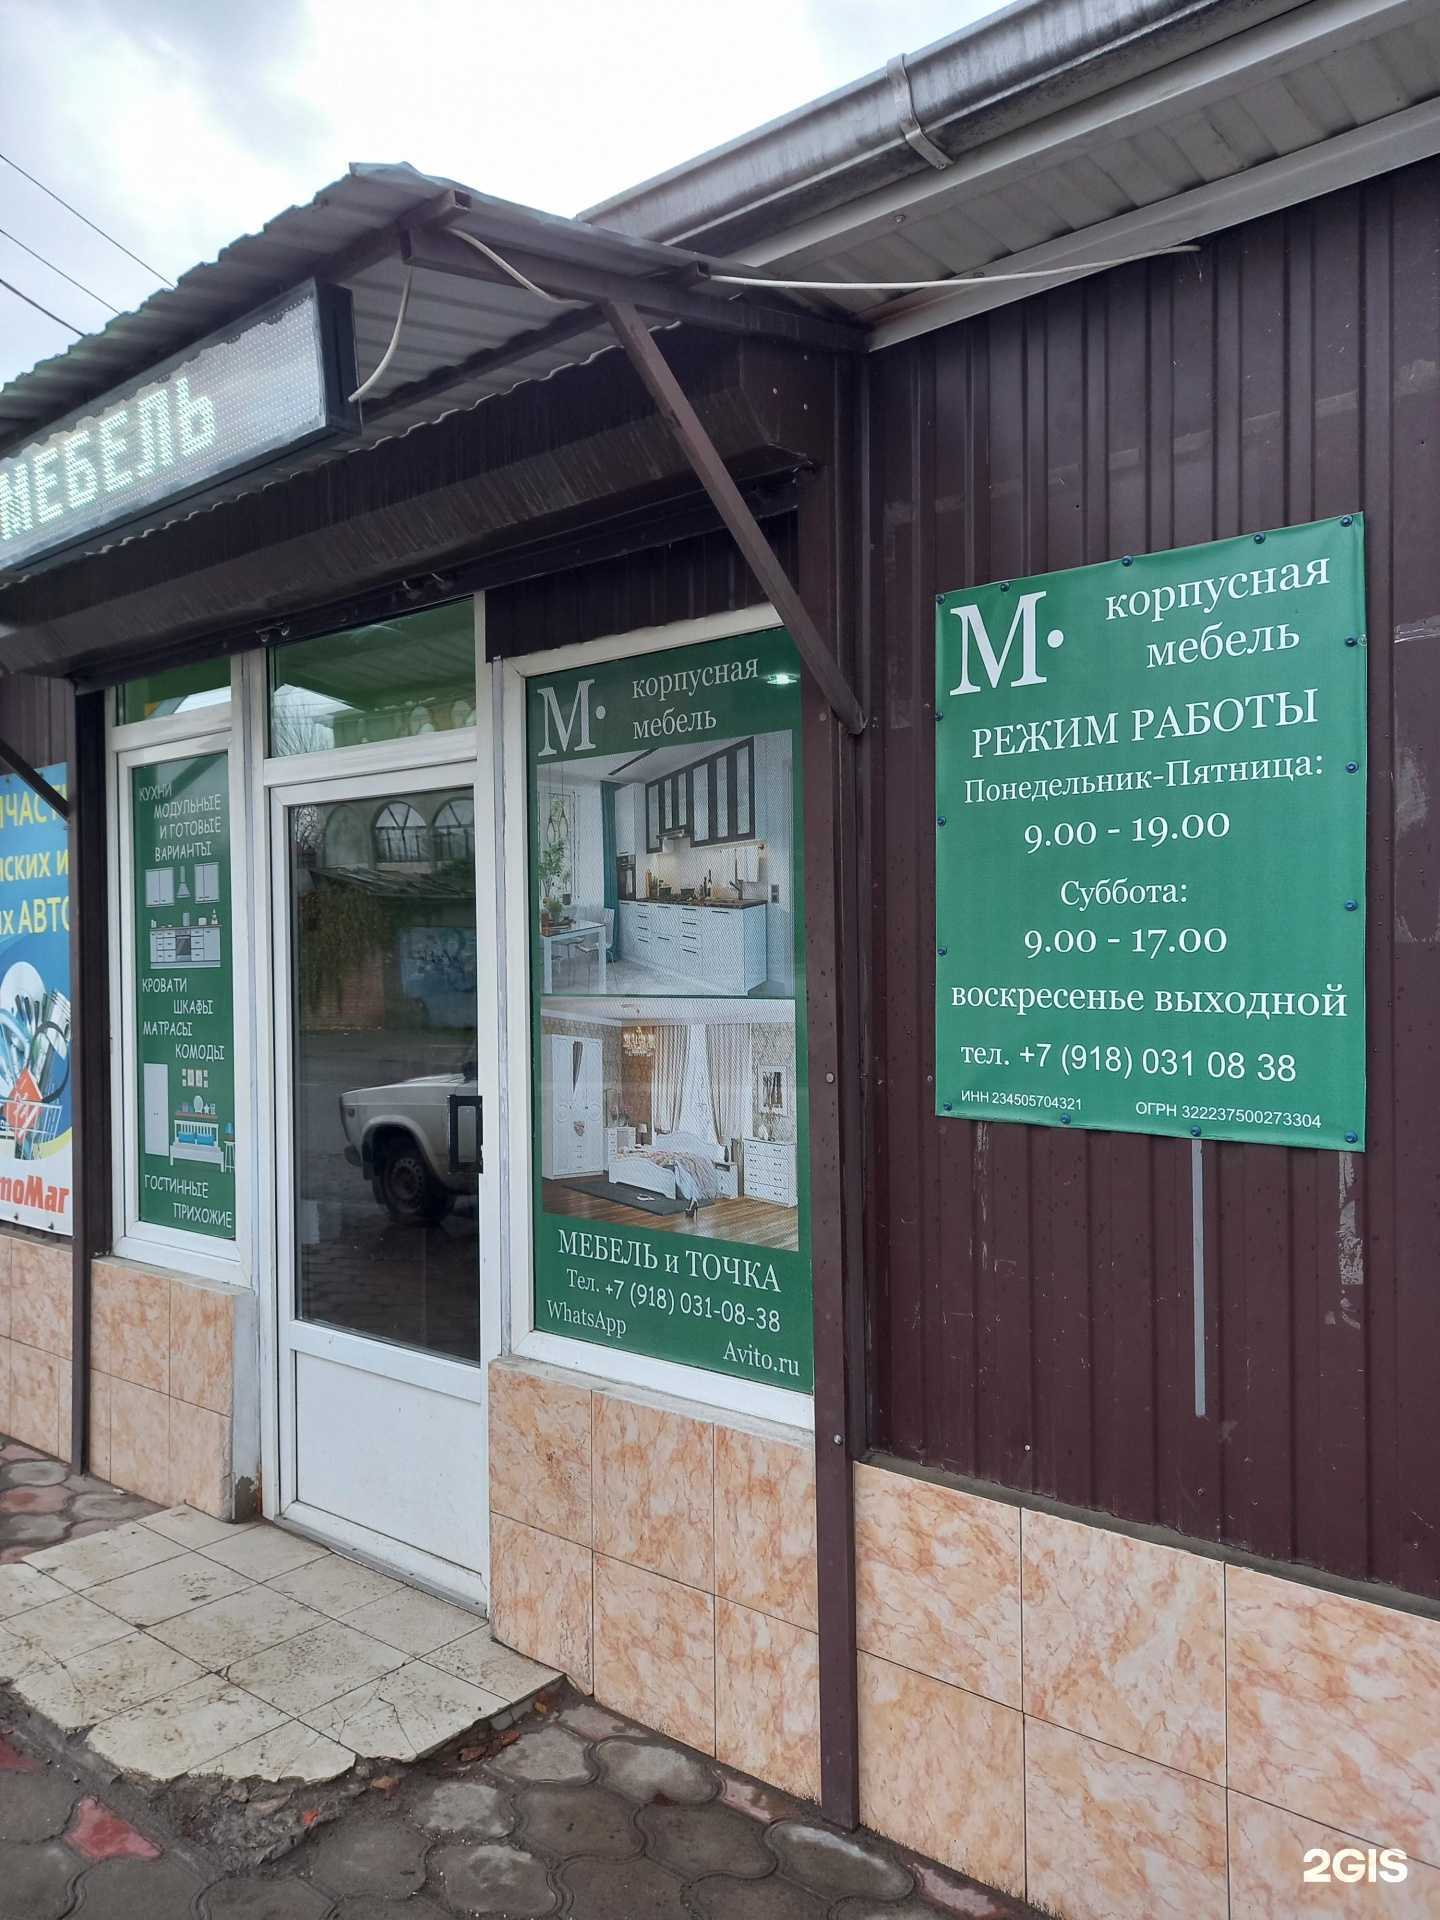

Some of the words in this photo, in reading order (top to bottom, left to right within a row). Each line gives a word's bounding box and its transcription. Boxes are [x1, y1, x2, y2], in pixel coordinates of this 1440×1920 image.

[1105, 558, 1331, 622] корпусная
[1146, 622, 1300, 669] мебель
[632, 658, 759, 701] корпусная
[633, 707, 717, 740] мебель
[971, 712, 1118, 759] РЕЖИМ
[1131, 688, 1319, 742] РАБОТЫ
[139, 783, 173, 801] КУХНИ
[963, 754, 1324, 804] Понедельник-Пятница:
[154, 793, 222, 819] МОДУЛЬНЫЕ
[160, 825, 167, 839] И
[169, 816, 222, 838] ГОТОВЫЕ
[1024, 820, 1097, 855] 9.00
[1131, 812, 1231, 847] 19.00
[155, 841, 212, 862] ВАРИАНТЫ
[1060, 877, 1188, 912] Суббота:
[1024, 929, 1097, 959] 9.00
[1131, 927, 1227, 959] 17.00
[142, 978, 187, 993] КРОВАТИ
[951, 984, 1145, 1016] воскресенье
[1154, 984, 1348, 1018] выходной
[173, 1000, 213, 1015] ШКАФЫ
[143, 1021, 192, 1037] МАТРАСЫ
[175, 1044, 224, 1062] КОМОДЫ
[960, 1044, 1010, 1067] тел.
[1019, 1043, 1052, 1068] +7
[1061, 1044, 1133, 1079] (918)
[1142, 1048, 1194, 1077] 031
[1207, 1051, 1246, 1079] 08
[1257, 1053, 1297, 1082] 38
[961, 1090, 989, 1104] ИНН
[991, 1091, 1082, 1111] 234505704321
[1135, 1101, 1177, 1117] ОГРН
[1182, 1105, 1322, 1130] 322237500273304
[144, 1175, 208, 1198] ГОСТИННЫЕ
[173, 1202, 232, 1228] ПРИХОЖИЕ
[558, 1229, 658, 1269] МЕБЕЛЬ
[665, 1254, 679, 1274] и
[686, 1250, 782, 1293] ТОЧКА
[566, 1268, 599, 1292] Тел.
[605, 1280, 624, 1300] +7
[630, 1281, 675, 1316] (918)
[680, 1292, 781, 1333] 031-08-38
[546, 1300, 627, 1339] WhatsApp
[723, 1341, 800, 1376] Avito.ru
